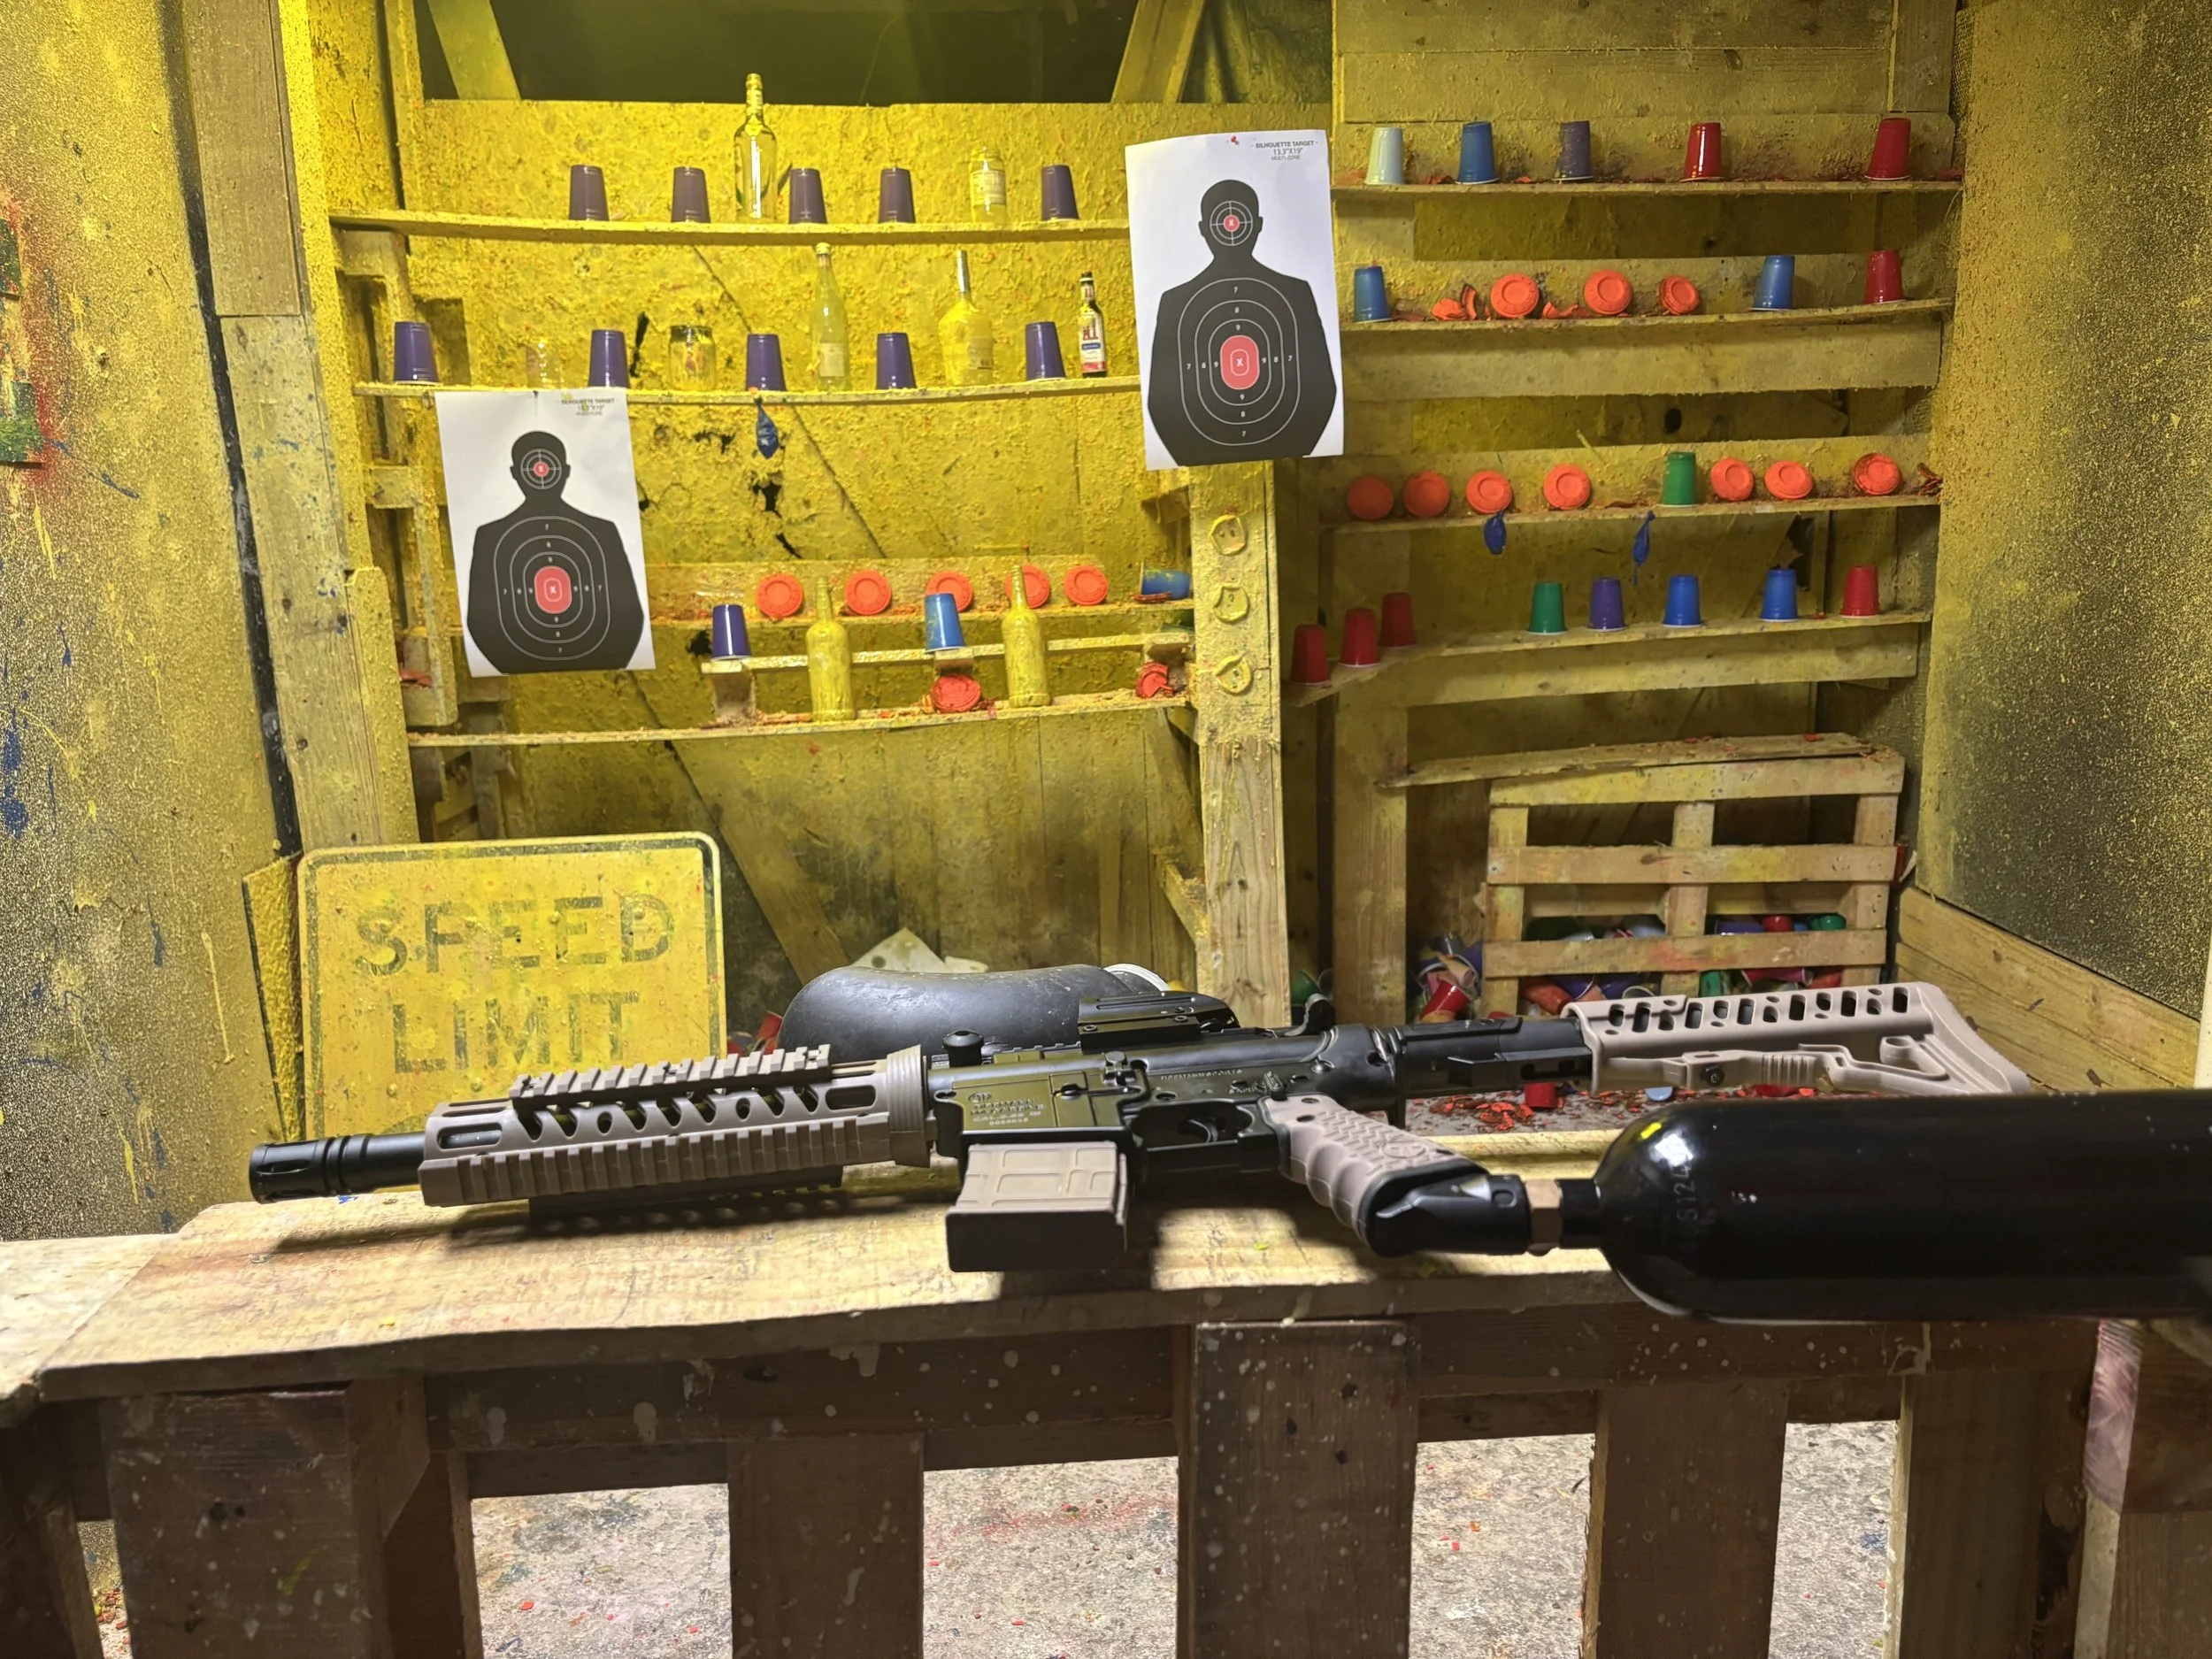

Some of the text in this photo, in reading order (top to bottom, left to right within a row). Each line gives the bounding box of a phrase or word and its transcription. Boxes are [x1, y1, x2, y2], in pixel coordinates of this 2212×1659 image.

[1236, 357, 1244, 367] X
[549, 585, 557, 595] X
[356, 893, 675, 975] SPEED
[392, 991, 639, 1074] LIMIT
